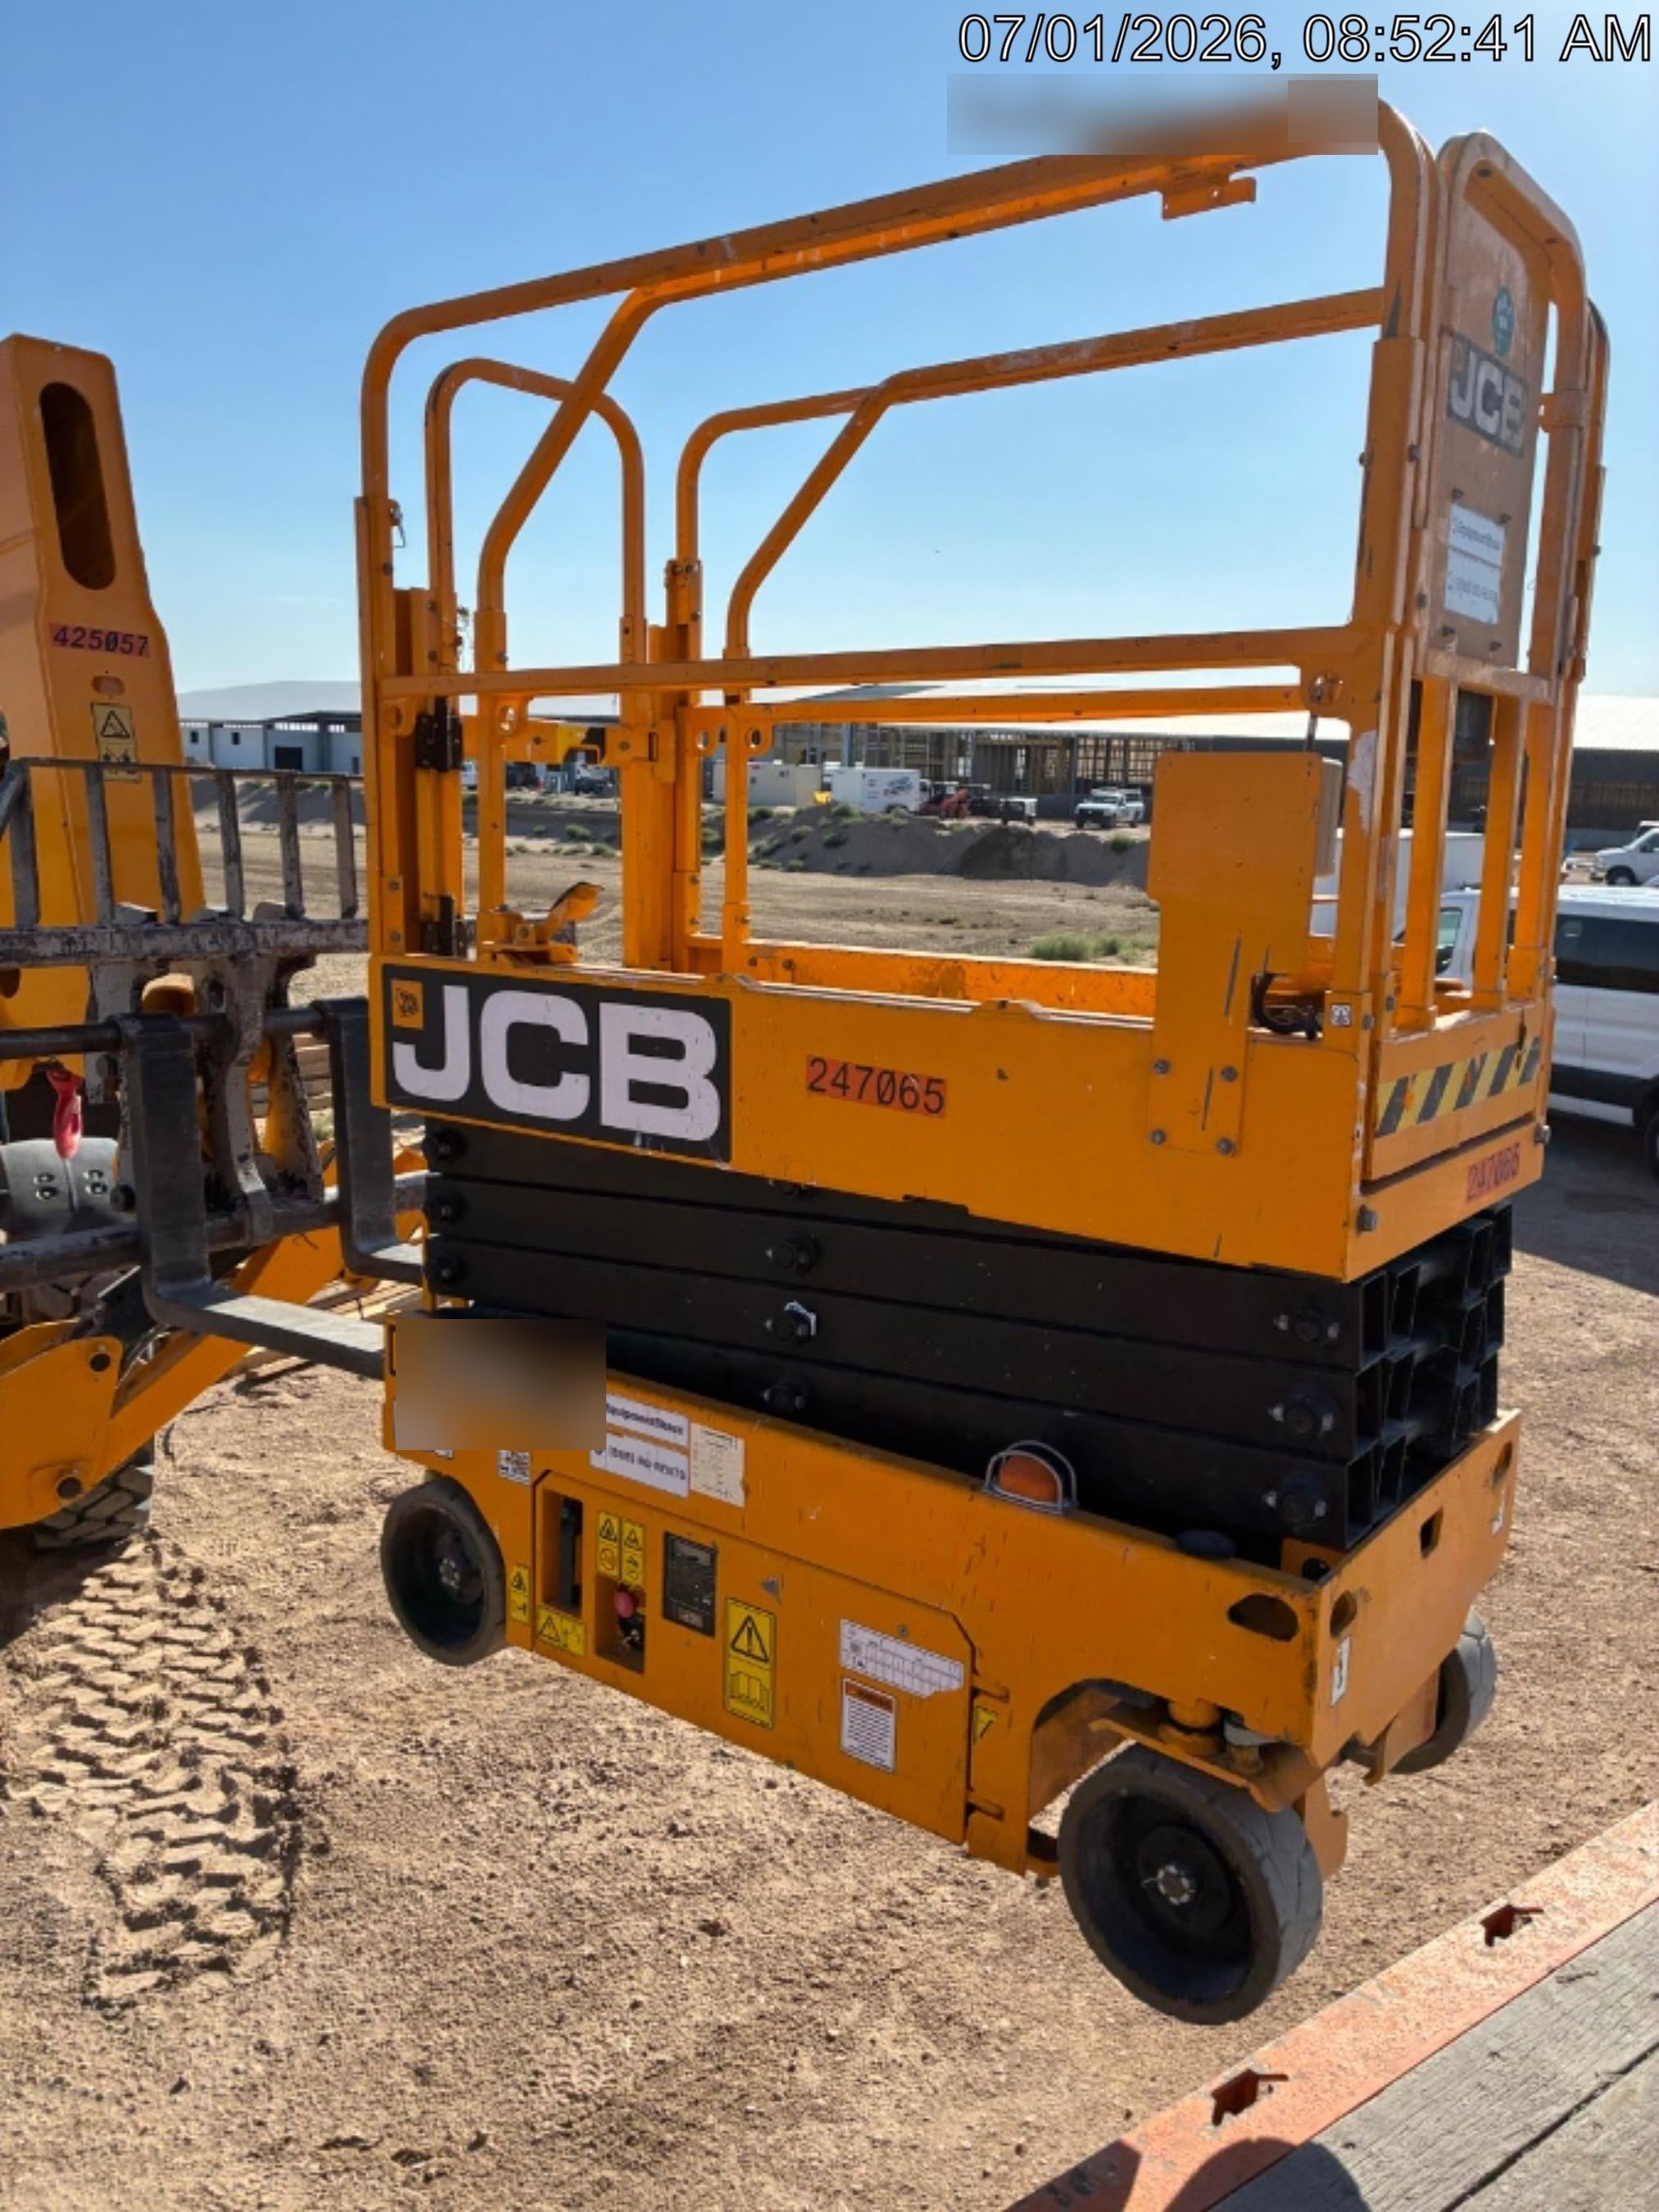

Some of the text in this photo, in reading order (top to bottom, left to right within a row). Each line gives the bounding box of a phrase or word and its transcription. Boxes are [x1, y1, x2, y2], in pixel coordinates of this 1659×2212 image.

[1450, 350, 1524, 451] JCB
[53, 626, 147, 655] 425057
[392, 985, 722, 1142] JCB
[808, 1057, 945, 1114] 247065
